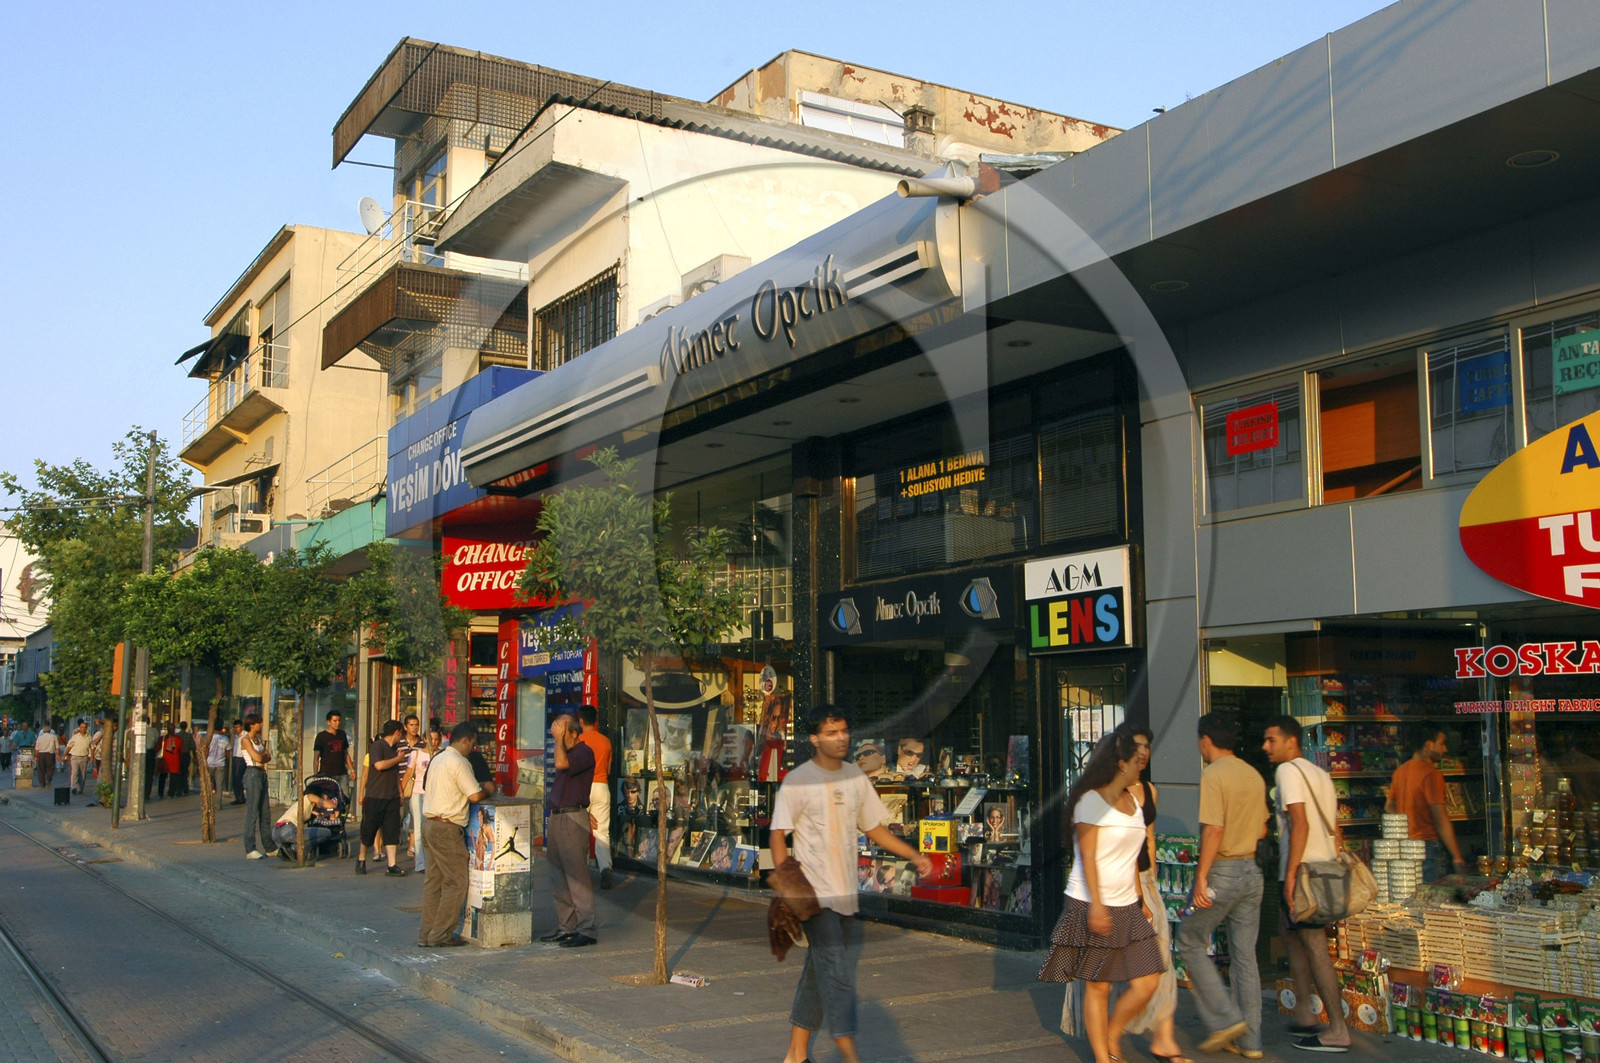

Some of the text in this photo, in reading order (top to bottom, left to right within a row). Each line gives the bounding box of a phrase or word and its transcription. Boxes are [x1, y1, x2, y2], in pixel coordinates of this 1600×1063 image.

[659, 254, 846, 381] Ahmet Optik
[1559, 361, 1600, 383] REÇ
[1231, 412, 1273, 432] TURKISH
[1231, 426, 1274, 447] DELIGHT
[408, 421, 458, 461] CHANGE OFFICE
[391, 446, 468, 513] YEŞİM DÖV
[899, 449, 985, 484] 1 ALANA 1 BEDAVA
[953, 467, 986, 487] HEDİYE
[453, 540, 537, 566] CHANGE
[457, 569, 528, 592] OFFICE
[1045, 561, 1103, 594] AGM
[1030, 593, 1120, 648] LENS
[1454, 640, 1600, 679] KOSKA
[498, 641, 509, 762] CHANGE
[1454, 700, 1503, 714] TURKISH
[1505, 699, 1556, 713] DELIGHT
